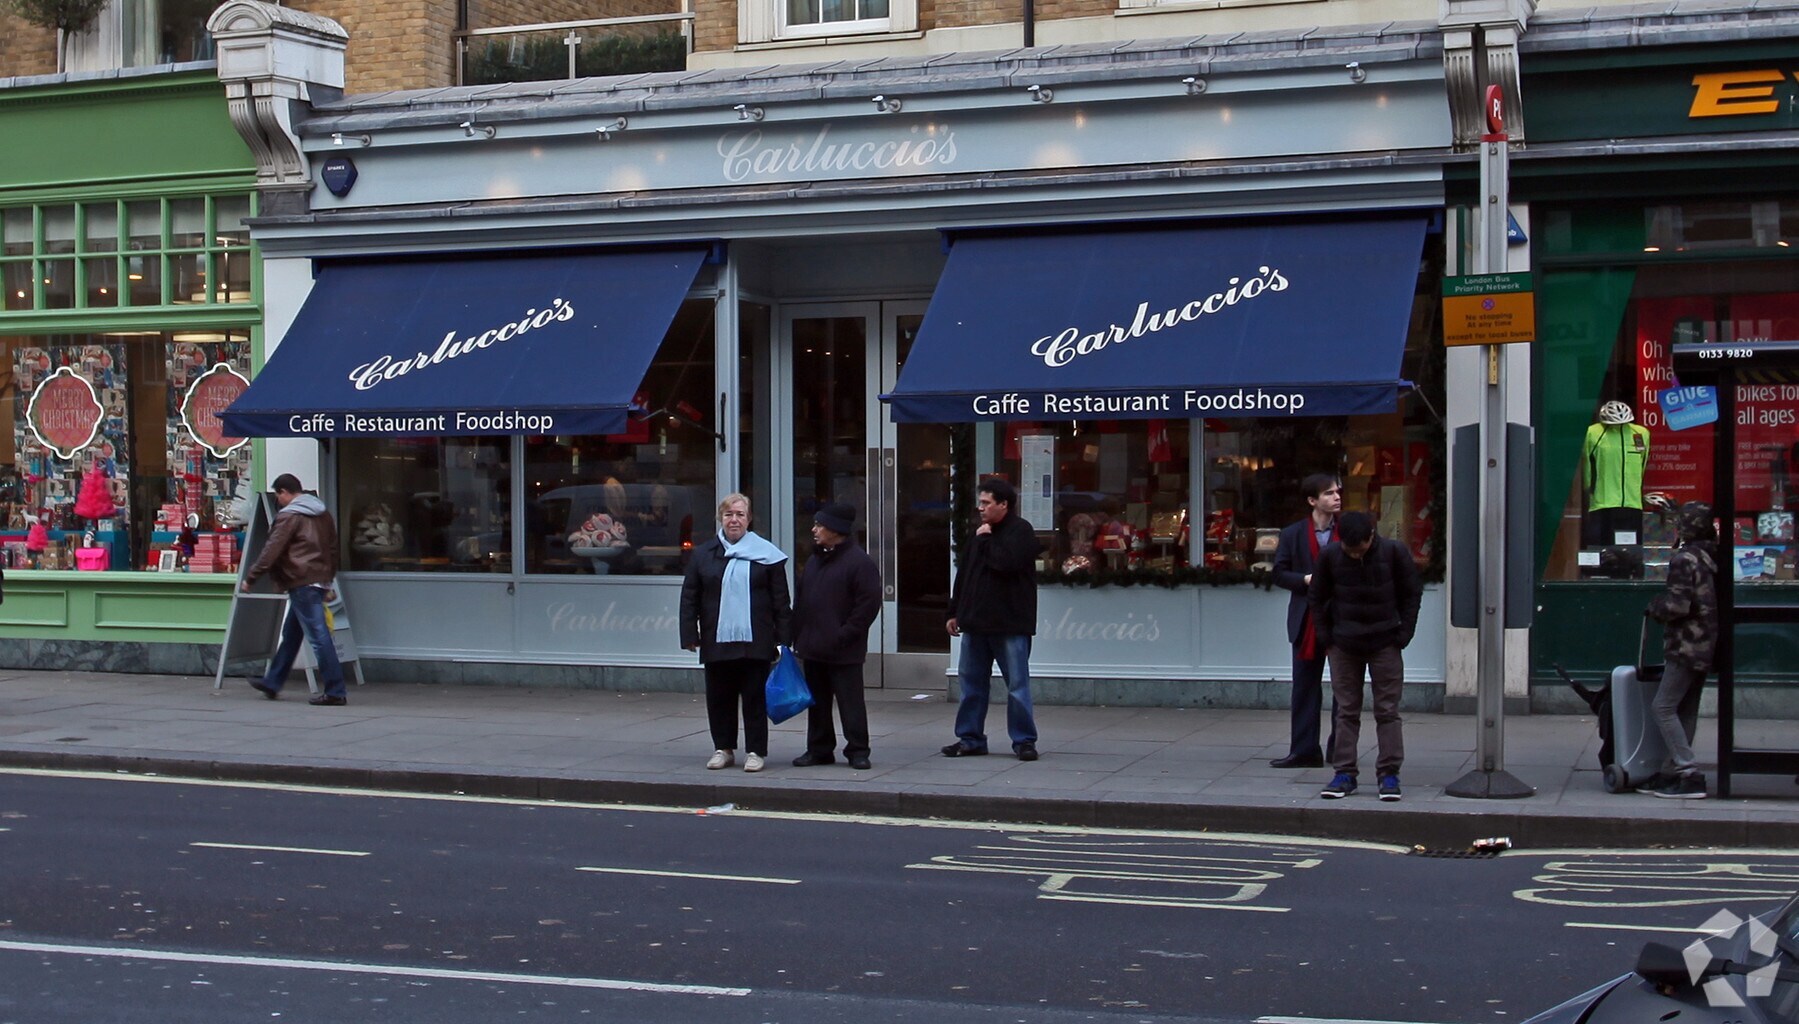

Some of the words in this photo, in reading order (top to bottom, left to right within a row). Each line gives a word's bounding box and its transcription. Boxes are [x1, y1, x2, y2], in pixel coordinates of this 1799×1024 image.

[1688, 69, 1799, 118] E
[716, 124, 958, 182] Carluccio's
[1455, 285, 1484, 293] Priority
[1486, 283, 1520, 291] Network
[1464, 276, 1492, 285] London
[1495, 275, 1510, 283] Bus
[1031, 266, 1289, 367] Carluccio's
[349, 298, 574, 390] Carluccio's
[1643, 340, 1663, 359] Oh
[1699, 350, 1723, 359] 0133
[1727, 349, 1753, 359] 9820
[1643, 363, 1675, 382] wha
[53, 389, 86, 410] MERRY
[973, 393, 1030, 415] Caffe
[1044, 392, 1170, 413] Restaurant
[1184, 389, 1305, 414] Foodshop
[1643, 386, 1659, 404] fu
[1665, 386, 1710, 405] GIVE
[1737, 385, 1777, 402] bikes
[42, 409, 97, 430] CHRISTMAS
[289, 414, 335, 433] Caffe
[345, 414, 445, 432] Restaurant
[456, 410, 553, 434] Foodshop
[1643, 409, 1658, 427] to
[1737, 406, 1755, 424] all
[1759, 409, 1796, 427] ages
